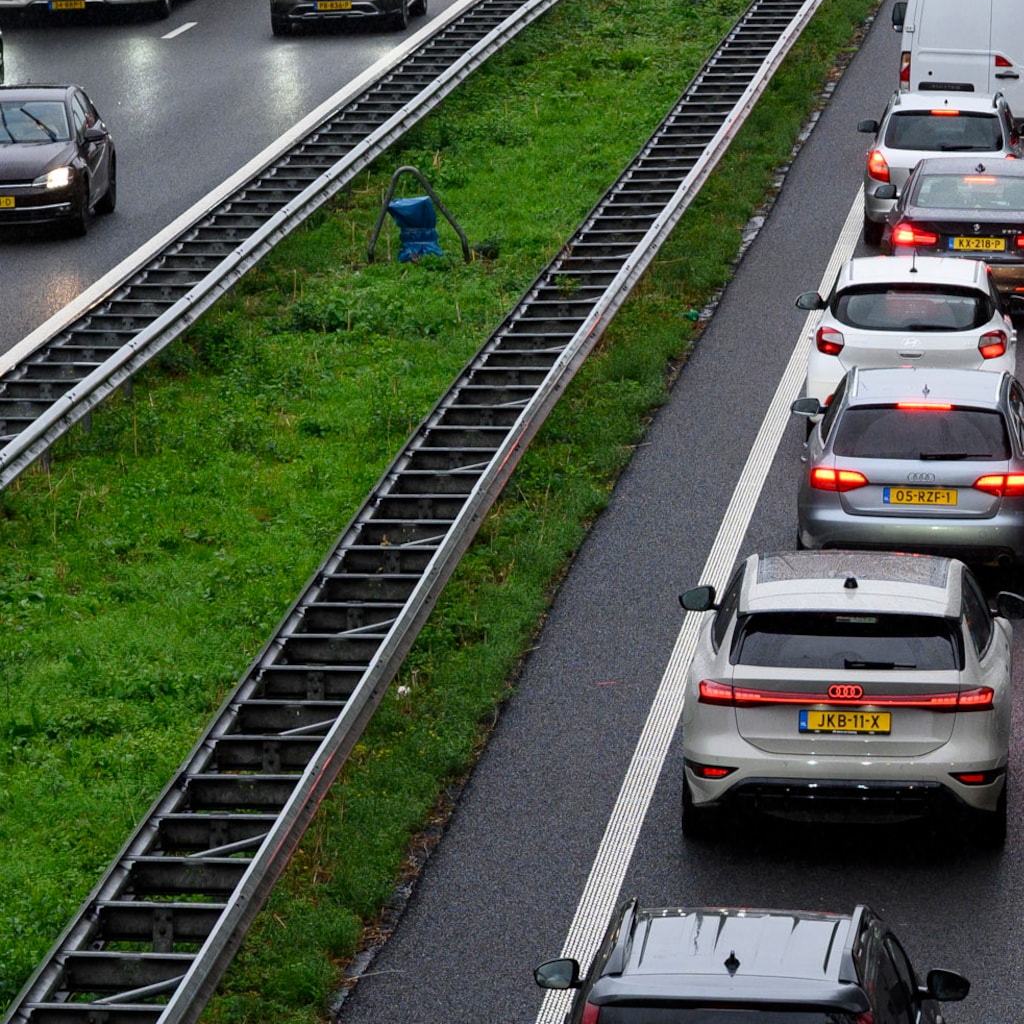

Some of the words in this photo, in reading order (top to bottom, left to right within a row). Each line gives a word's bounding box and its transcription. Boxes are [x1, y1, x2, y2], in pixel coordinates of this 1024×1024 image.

[958, 239, 1001, 249] KX-218-P
[896, 490, 950, 503] 05-RZF-1
[818, 714, 880, 729] JKB-11-X
